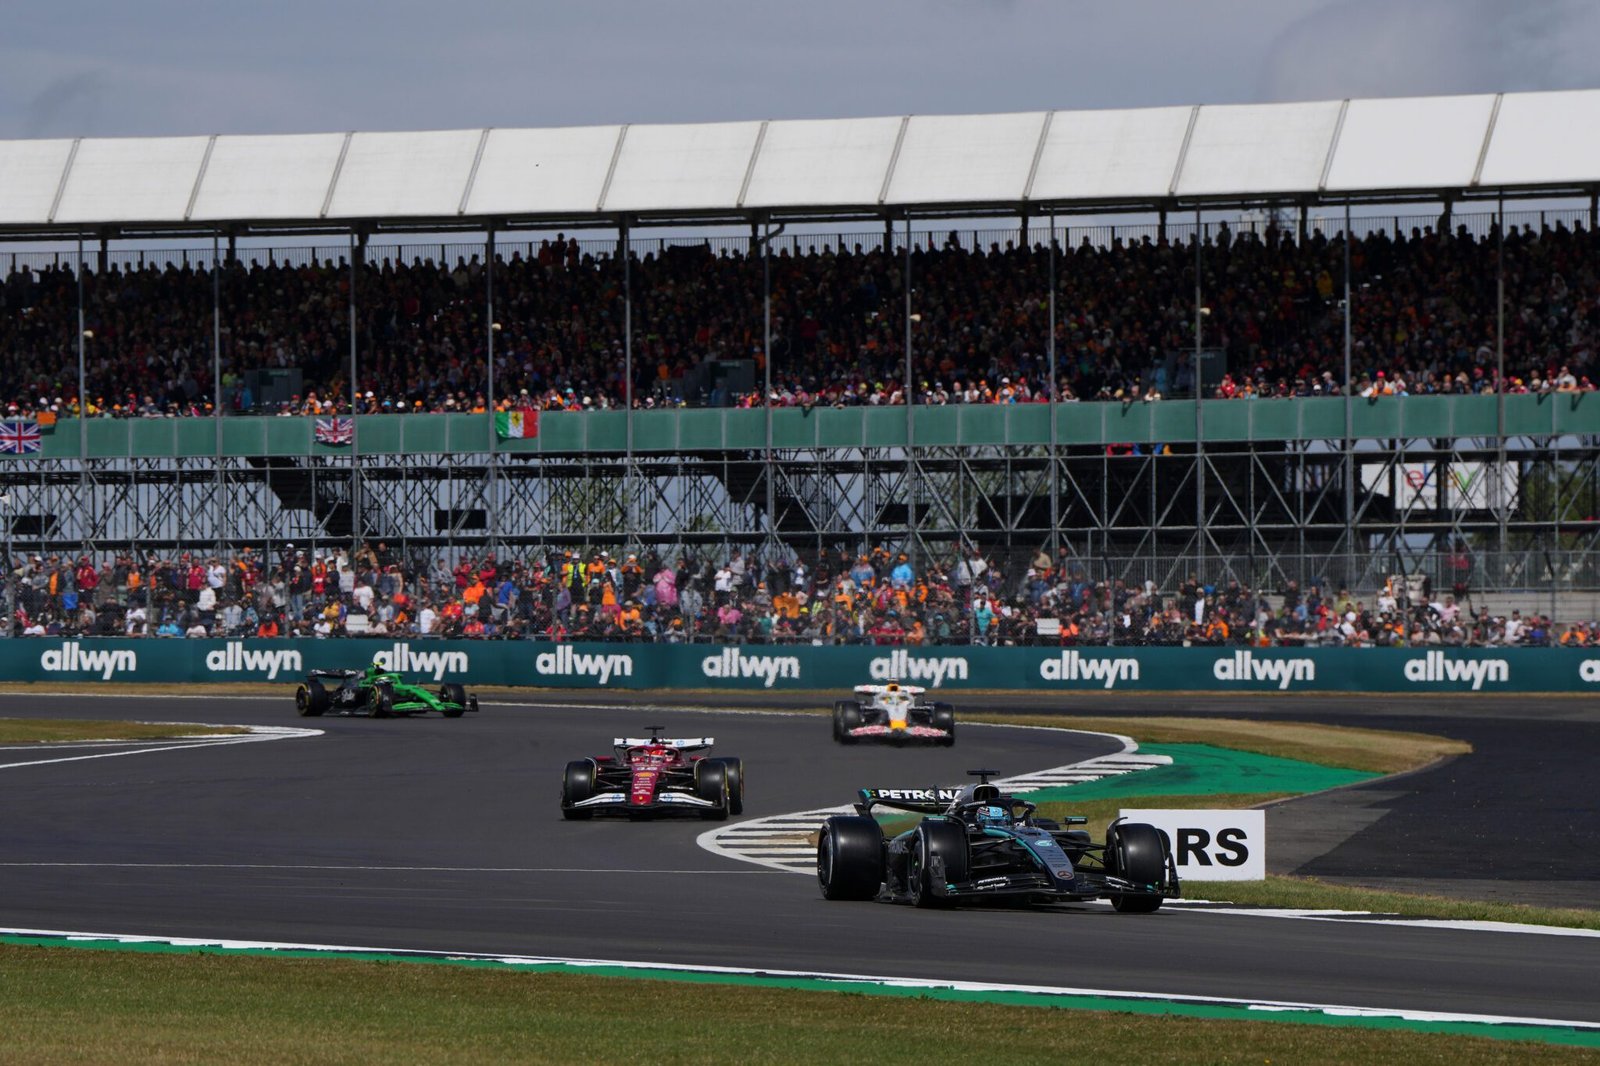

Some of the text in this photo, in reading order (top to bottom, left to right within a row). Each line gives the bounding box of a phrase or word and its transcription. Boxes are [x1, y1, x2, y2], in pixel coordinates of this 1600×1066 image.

[41, 642, 136, 680] allwyn
[206, 642, 302, 680] allwyn
[372, 642, 468, 680] allwyn
[536, 645, 633, 684] allwyn
[702, 648, 800, 687] allwyn
[870, 650, 968, 688] allwyn
[1040, 650, 1139, 689] allwyn
[1213, 650, 1315, 690] allwyn
[1404, 651, 1509, 690] allwyn
[878, 789, 962, 800] PETRON
